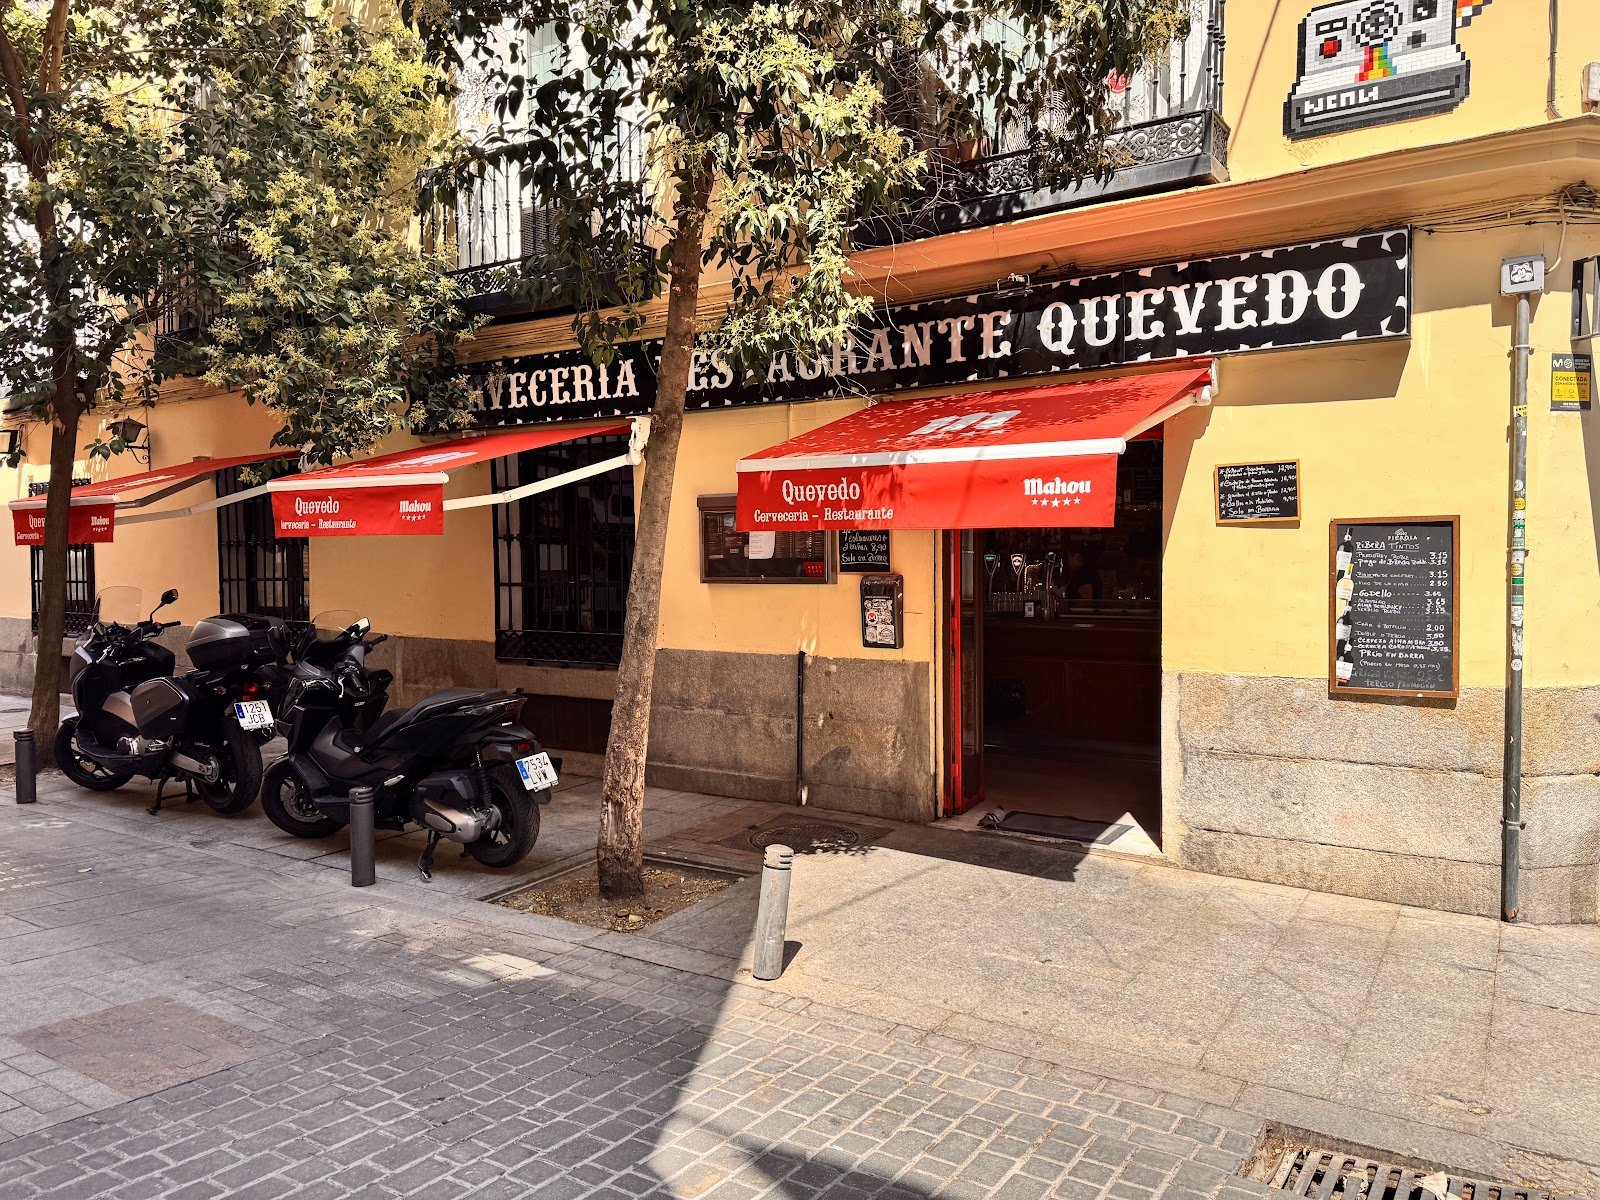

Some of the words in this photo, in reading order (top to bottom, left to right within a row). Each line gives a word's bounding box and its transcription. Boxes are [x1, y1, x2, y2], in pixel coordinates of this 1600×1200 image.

[655, 310, 1012, 391] ESAURANTE
[1036, 263, 1365, 356] QUEVEDO
[782, 477, 861, 505] Quevedo
[1024, 476, 1091, 496] Mahou
[295, 496, 340, 516] Quevedo
[399, 500, 431, 513] Mahou
[824, 507, 894, 521] Restaurante
[29, 514, 45, 529] Quev
[318, 518, 356, 529] Restaurante
[1398, 652, 1425, 660] BARRA
[244, 702, 267, 713] 1251
[249, 714, 265, 724] JCB
[525, 756, 548, 772] 7534
